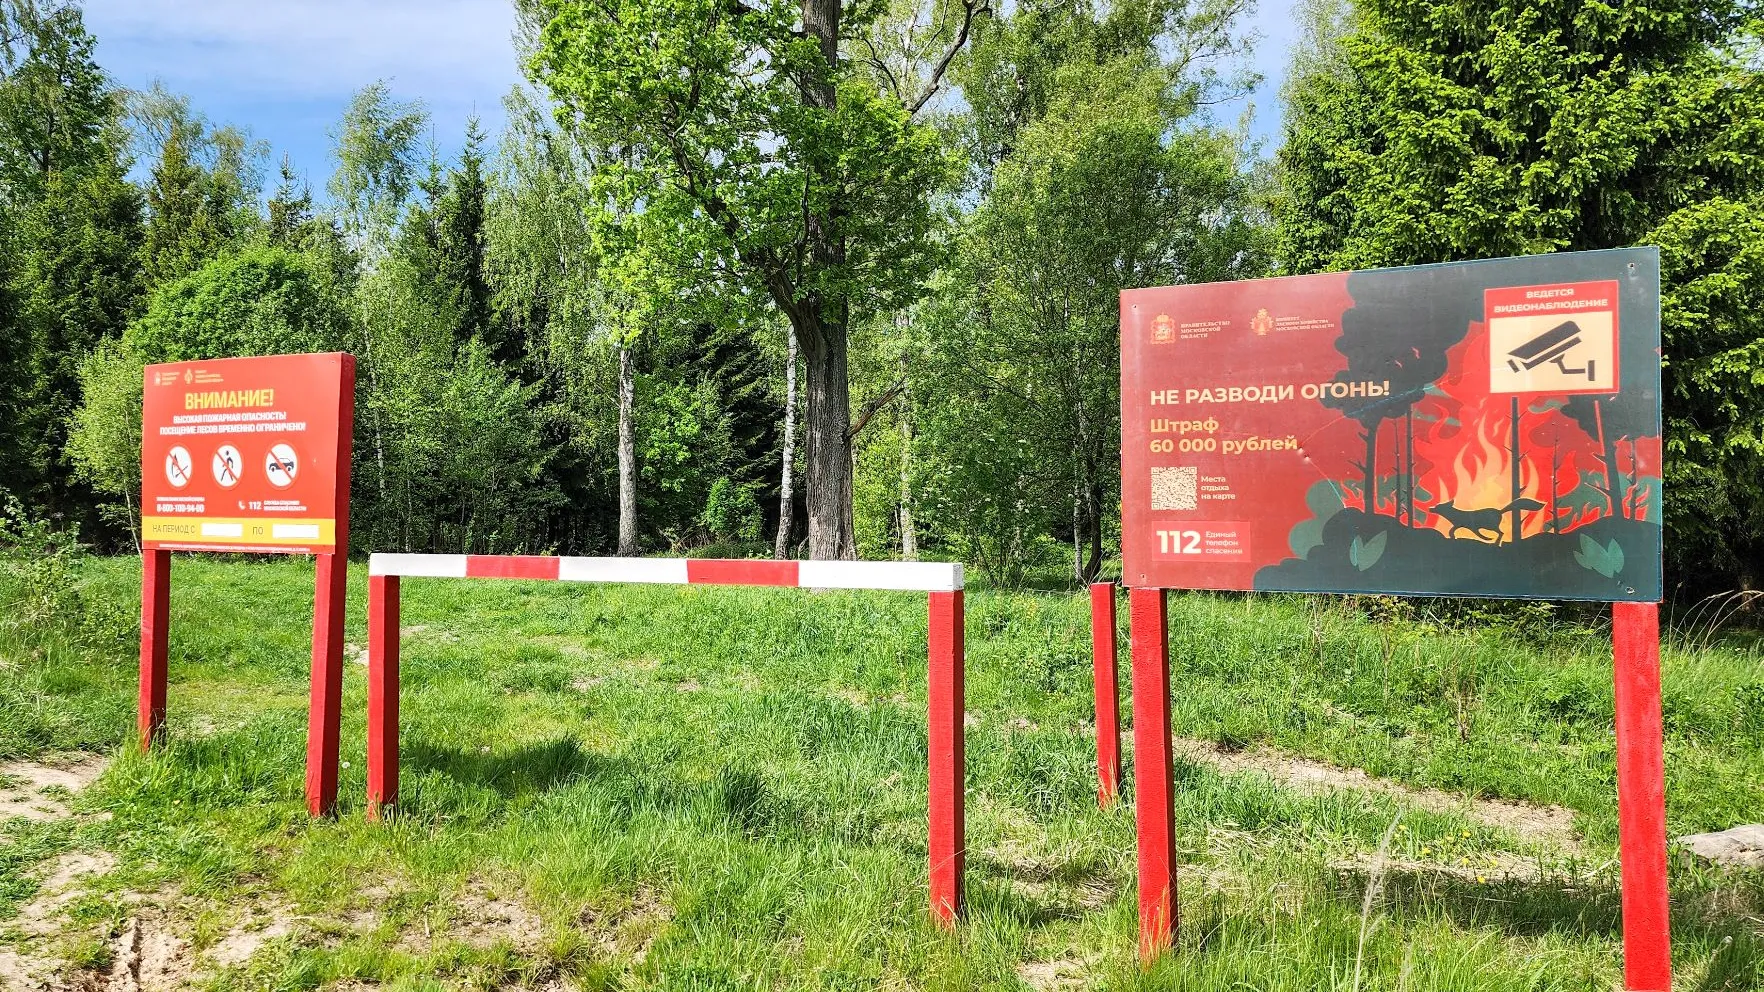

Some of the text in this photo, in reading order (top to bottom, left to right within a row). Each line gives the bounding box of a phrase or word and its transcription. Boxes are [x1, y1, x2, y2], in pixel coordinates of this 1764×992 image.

[1526, 288, 1574, 298] ВЕДЕТСЯ
[1494, 299, 1608, 313] ВИДЕОНАБЛЮДЕНИЕ
[185, 388, 274, 410] ВНИМАНИЕ!
[1150, 380, 1390, 406] НЕ РАЗВОДИ ОГОНЬ!
[219, 423, 255, 434] ВРЕМЕННО
[1150, 417, 1219, 434] Штраф
[1150, 435, 1298, 454] 60 000 рублей
[248, 501, 262, 510] 112
[153, 524, 196, 534] НА ПЕРИОД С
[252, 526, 264, 534] ПО
[1156, 530, 1202, 554] 112
